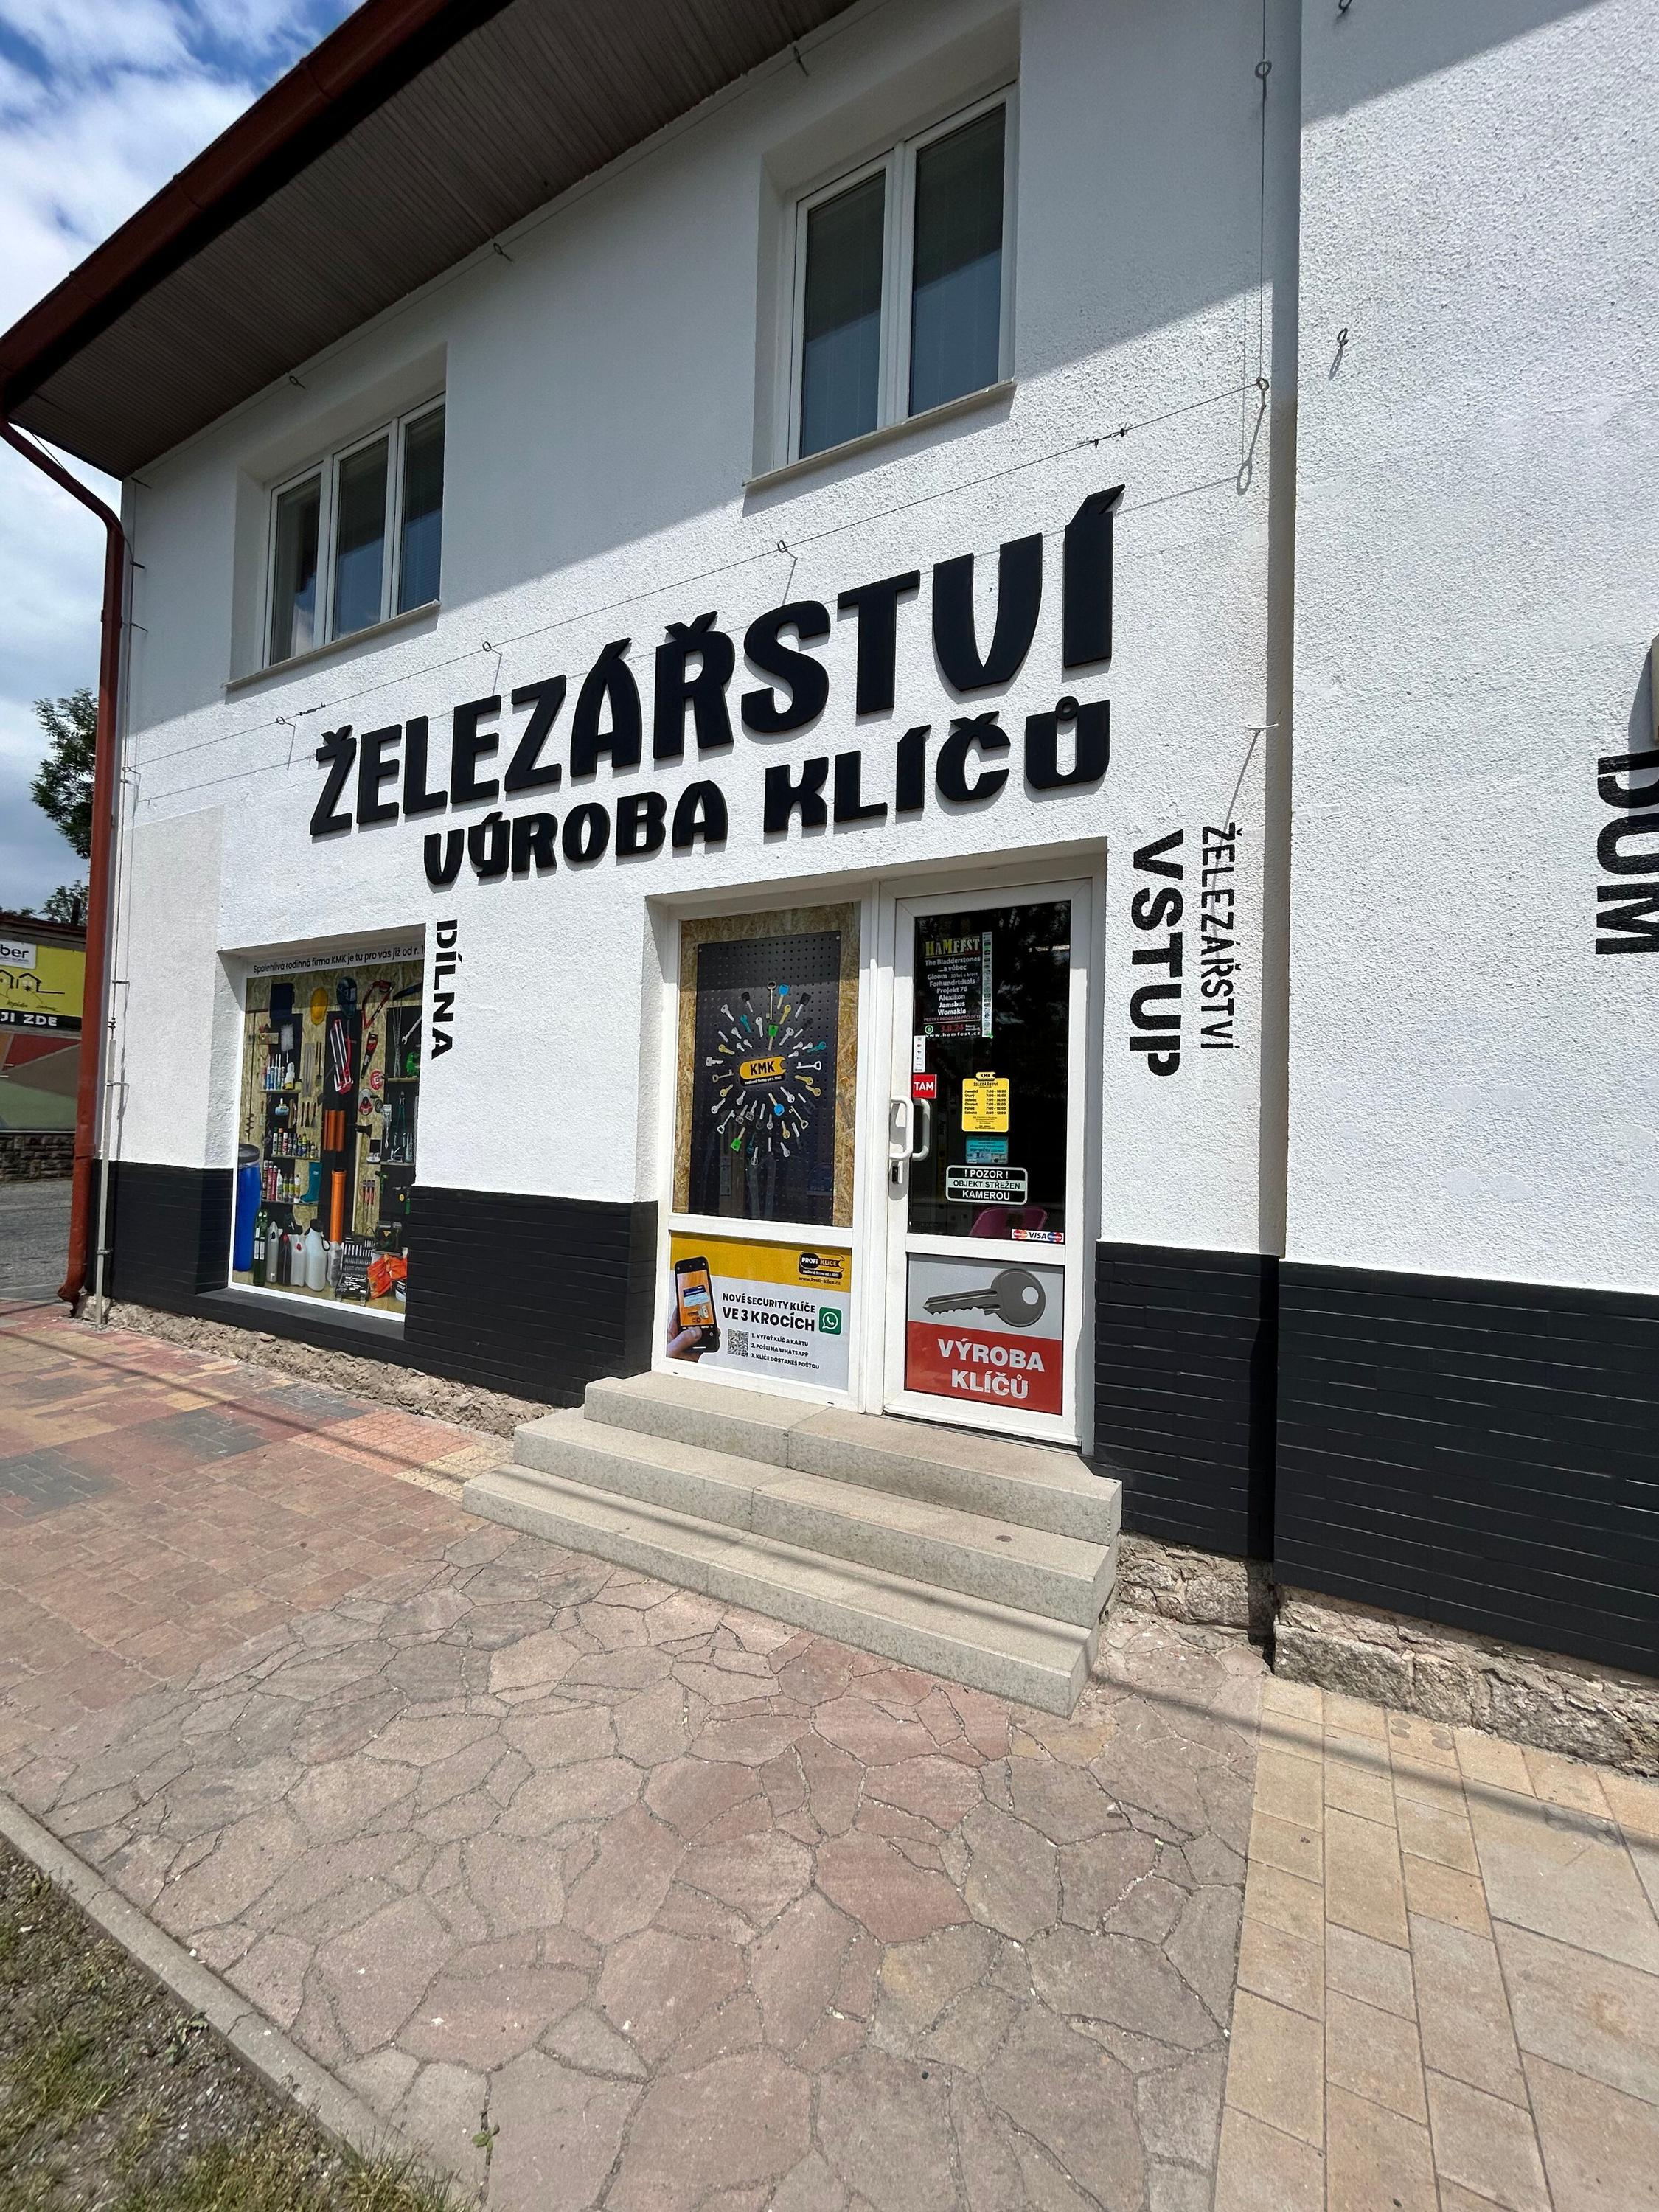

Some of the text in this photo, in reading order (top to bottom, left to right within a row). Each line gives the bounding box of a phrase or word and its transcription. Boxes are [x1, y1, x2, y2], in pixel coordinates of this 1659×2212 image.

[310, 484, 1126, 836] ŽELEZÁŘSTVÍ
[423, 695, 1110, 885] VÝROBA KLÍČŮ
[1200, 822, 1242, 1048] ŽELEZÁŘSTVÍ
[285, 960, 310, 970] rodinná
[312, 958, 330, 967] firma
[331, 956, 346, 964] KMK
[347, 956, 354, 965] je
[355, 953, 363, 961] tu
[364, 953, 377, 963] pro
[402, 946, 412, 956] od
[1130, 829, 1183, 1076] VSTUP
[431, 919, 462, 1060] DÍLNA
[23, 1014, 58, 1026] ZDE
[750, 1060, 775, 1076] KMK
[914, 1082, 934, 1091] TAM
[970, 1170, 1004, 1179] POZOR
[984, 1180, 1020, 1189] STŘEŽEN
[962, 1190, 1010, 1200] KAMEROU
[723, 1293, 815, 1312] NOVÉ SECURITY KLÍČE
[723, 1306, 815, 1331] VE 3 KROCÍCH
[771, 1357, 797, 1366] DOSTANEŠ
[798, 1361, 820, 1369] POŠTOU
[779, 1348, 808, 1357] WHATSAPP
[937, 1338, 1045, 1372] VÝROBA
[951, 1369, 1029, 1399] KLÍČŮ
